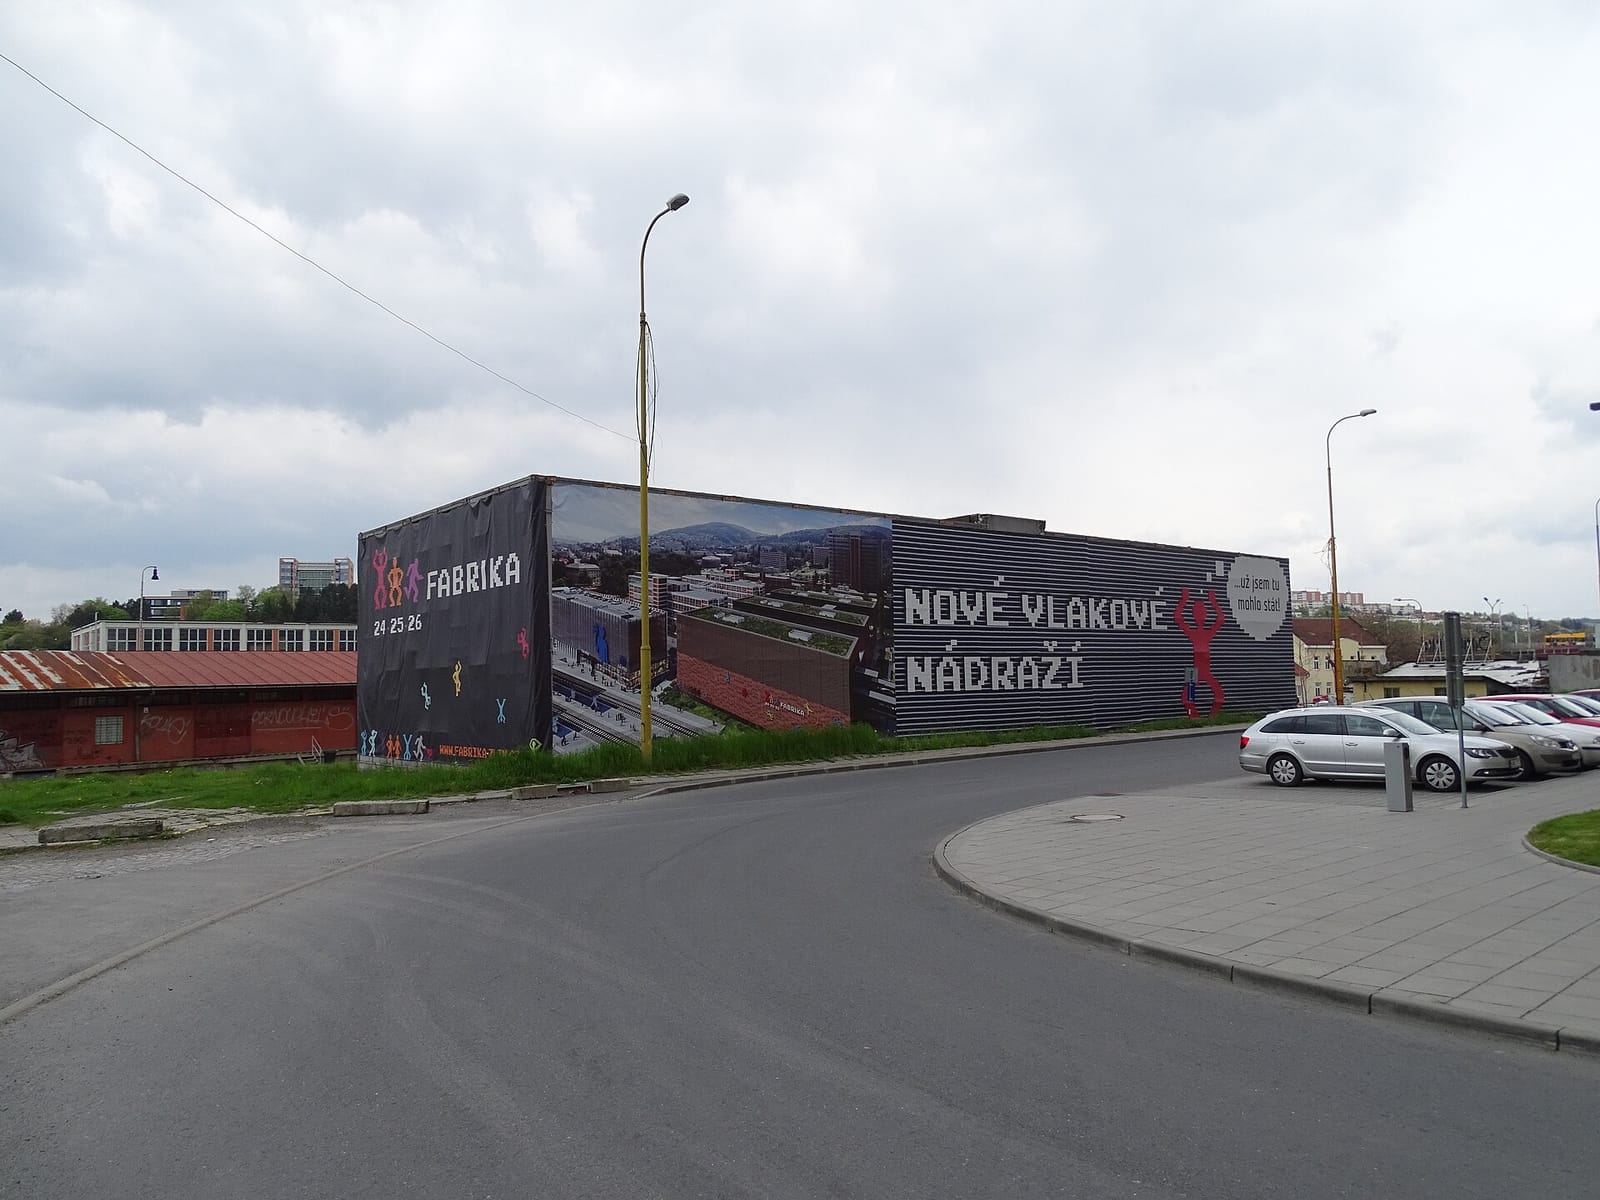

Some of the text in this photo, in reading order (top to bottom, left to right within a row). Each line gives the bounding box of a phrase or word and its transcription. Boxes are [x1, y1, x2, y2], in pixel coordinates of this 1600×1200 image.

[426, 552, 520, 600] FABRIKA
[1252, 575, 1270, 592] jsem
[1271, 578, 1280, 591] tu
[905, 575, 1168, 630] NOVÉ VLAKOVÉ
[1237, 595, 1281, 612] mohlo stát!
[907, 640, 1083, 692] NÁDRAŽÍ
